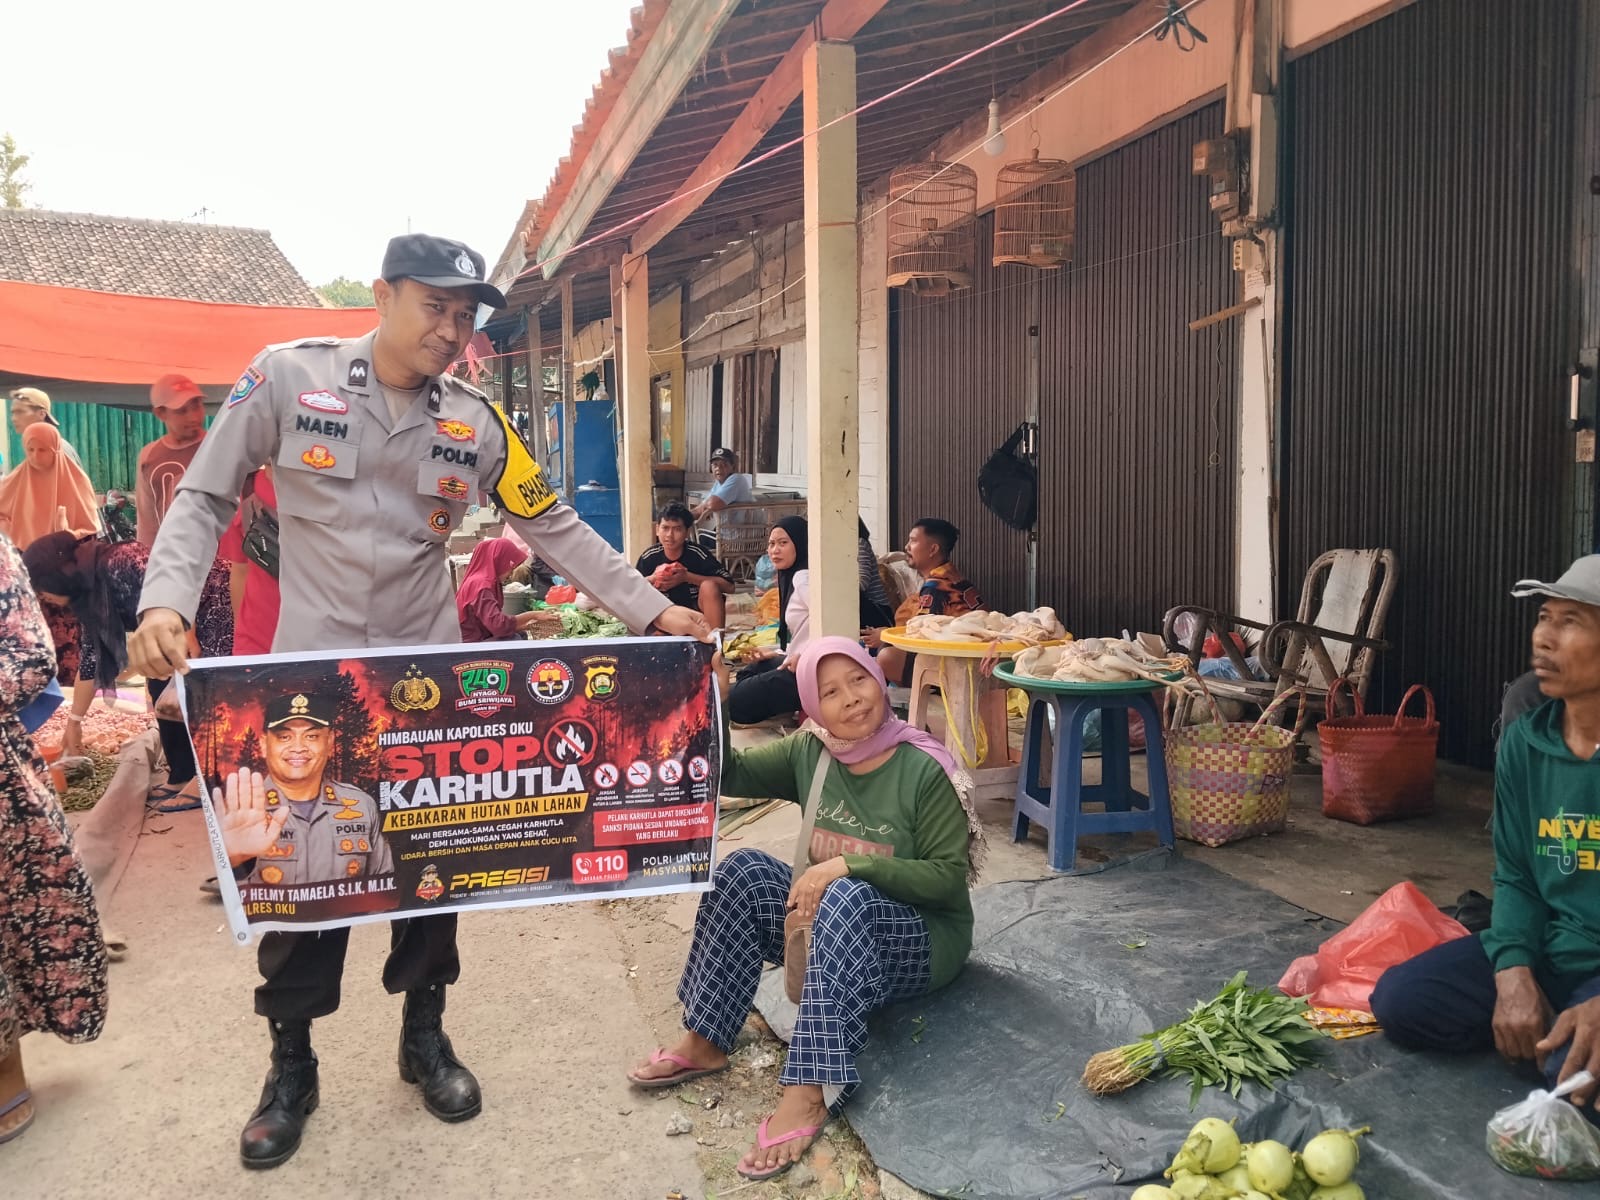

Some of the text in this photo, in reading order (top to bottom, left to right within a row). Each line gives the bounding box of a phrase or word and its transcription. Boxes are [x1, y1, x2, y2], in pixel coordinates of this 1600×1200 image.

[296, 414, 348, 439] NAEN
[431, 445, 478, 467] POLRI
[458, 698, 477, 707] BUMI
[378, 721, 533, 746] HIMBAUAN KAPOLRES OKU
[383, 735, 541, 782] STOP
[379, 763, 586, 811] KARHUTLA
[391, 796, 581, 828] KEBAKARAN HUTAN DAN LAHAN
[335, 824, 366, 835] POLRI
[410, 818, 564, 841] MARI BERSAMA-SAMA CEGAH KARHUTLA
[428, 840, 448, 849] DEMI
[449, 834, 500, 847] LINGKUNGAN
[502, 831, 522, 840] YANG
[635, 829, 679, 840] YANG BERLAKU
[400, 836, 578, 861] UDARA BERSIH DAN MASA DEPAN ANAK CUCU KITA
[642, 852, 710, 867] POLRI UNTUK
[595, 855, 624, 873] 110
[643, 863, 710, 877] MASYARAKAT
[250, 888, 285, 902] HELMY
[287, 885, 336, 902] TAMAELA
[367, 877, 397, 893] M.I.K.
[449, 866, 550, 891] PRESISI
[244, 902, 296, 916] LRES OKU
